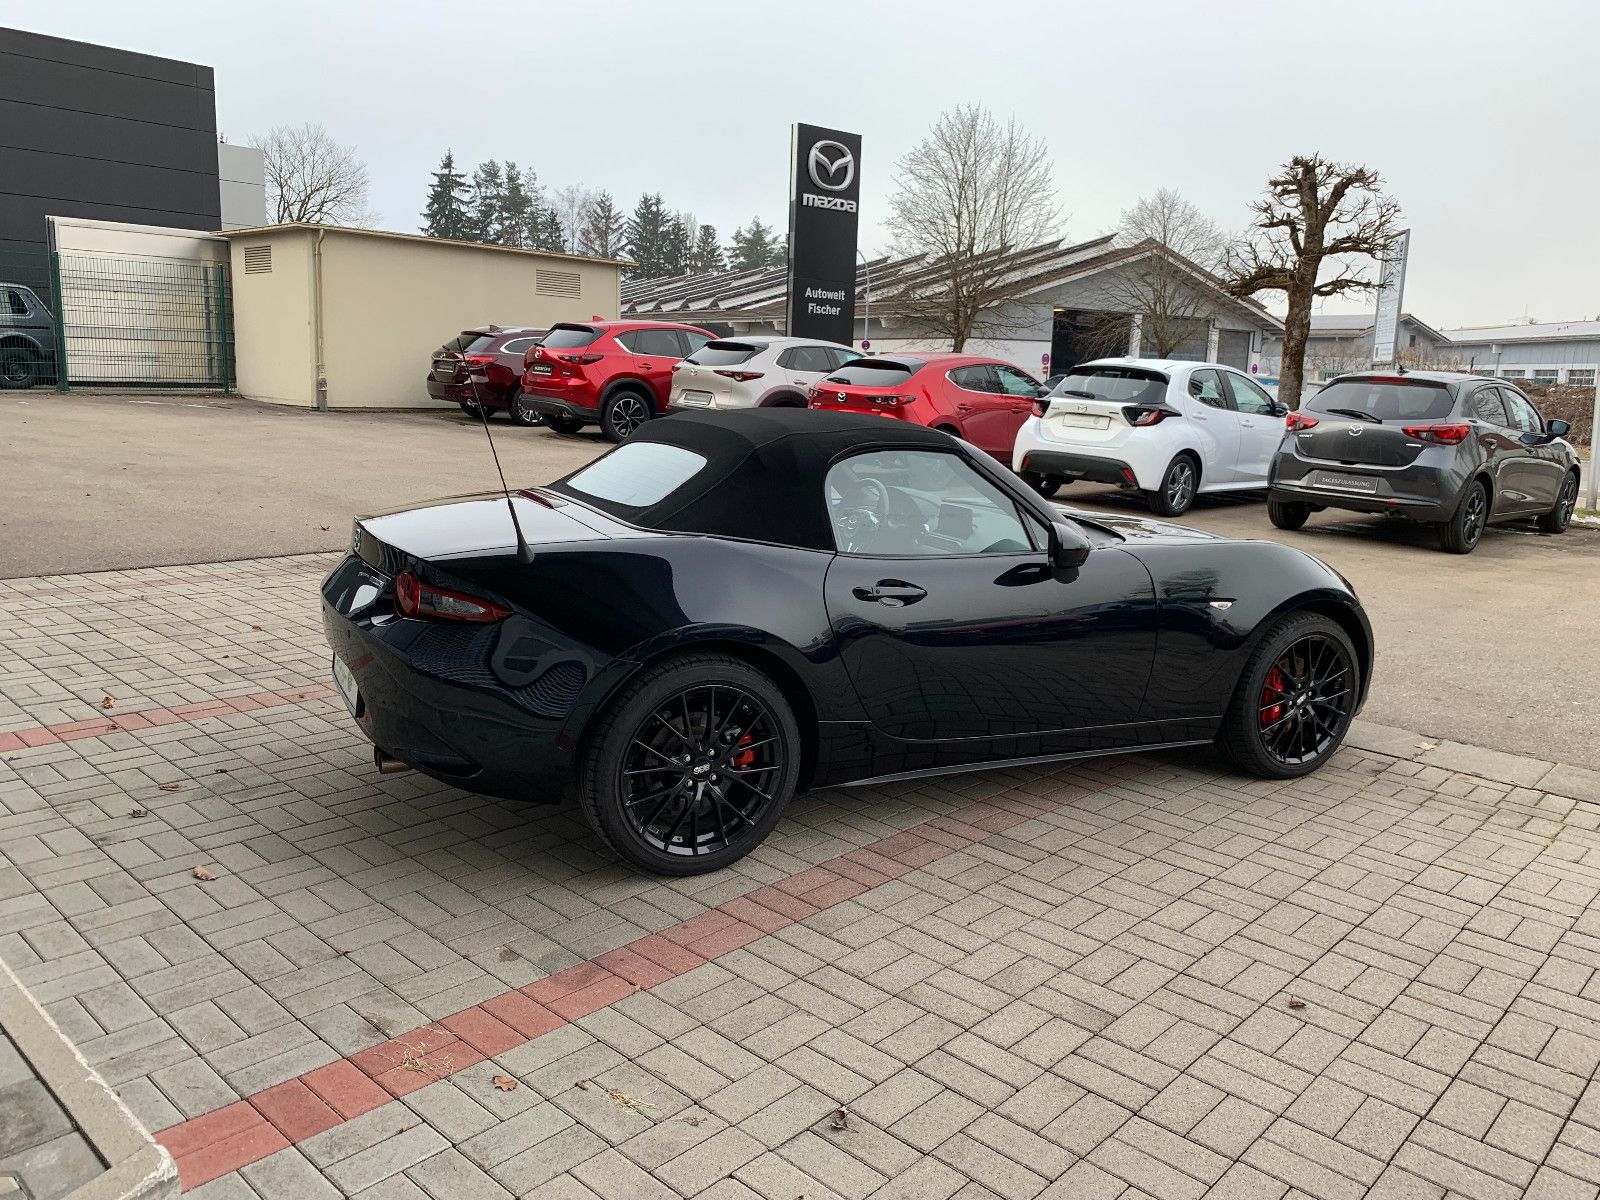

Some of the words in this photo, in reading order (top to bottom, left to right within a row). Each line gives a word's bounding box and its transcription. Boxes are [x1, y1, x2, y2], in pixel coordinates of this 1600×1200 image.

[802, 193, 857, 213] mazda
[805, 287, 846, 301] Autowelt
[808, 303, 841, 316] Fischer
